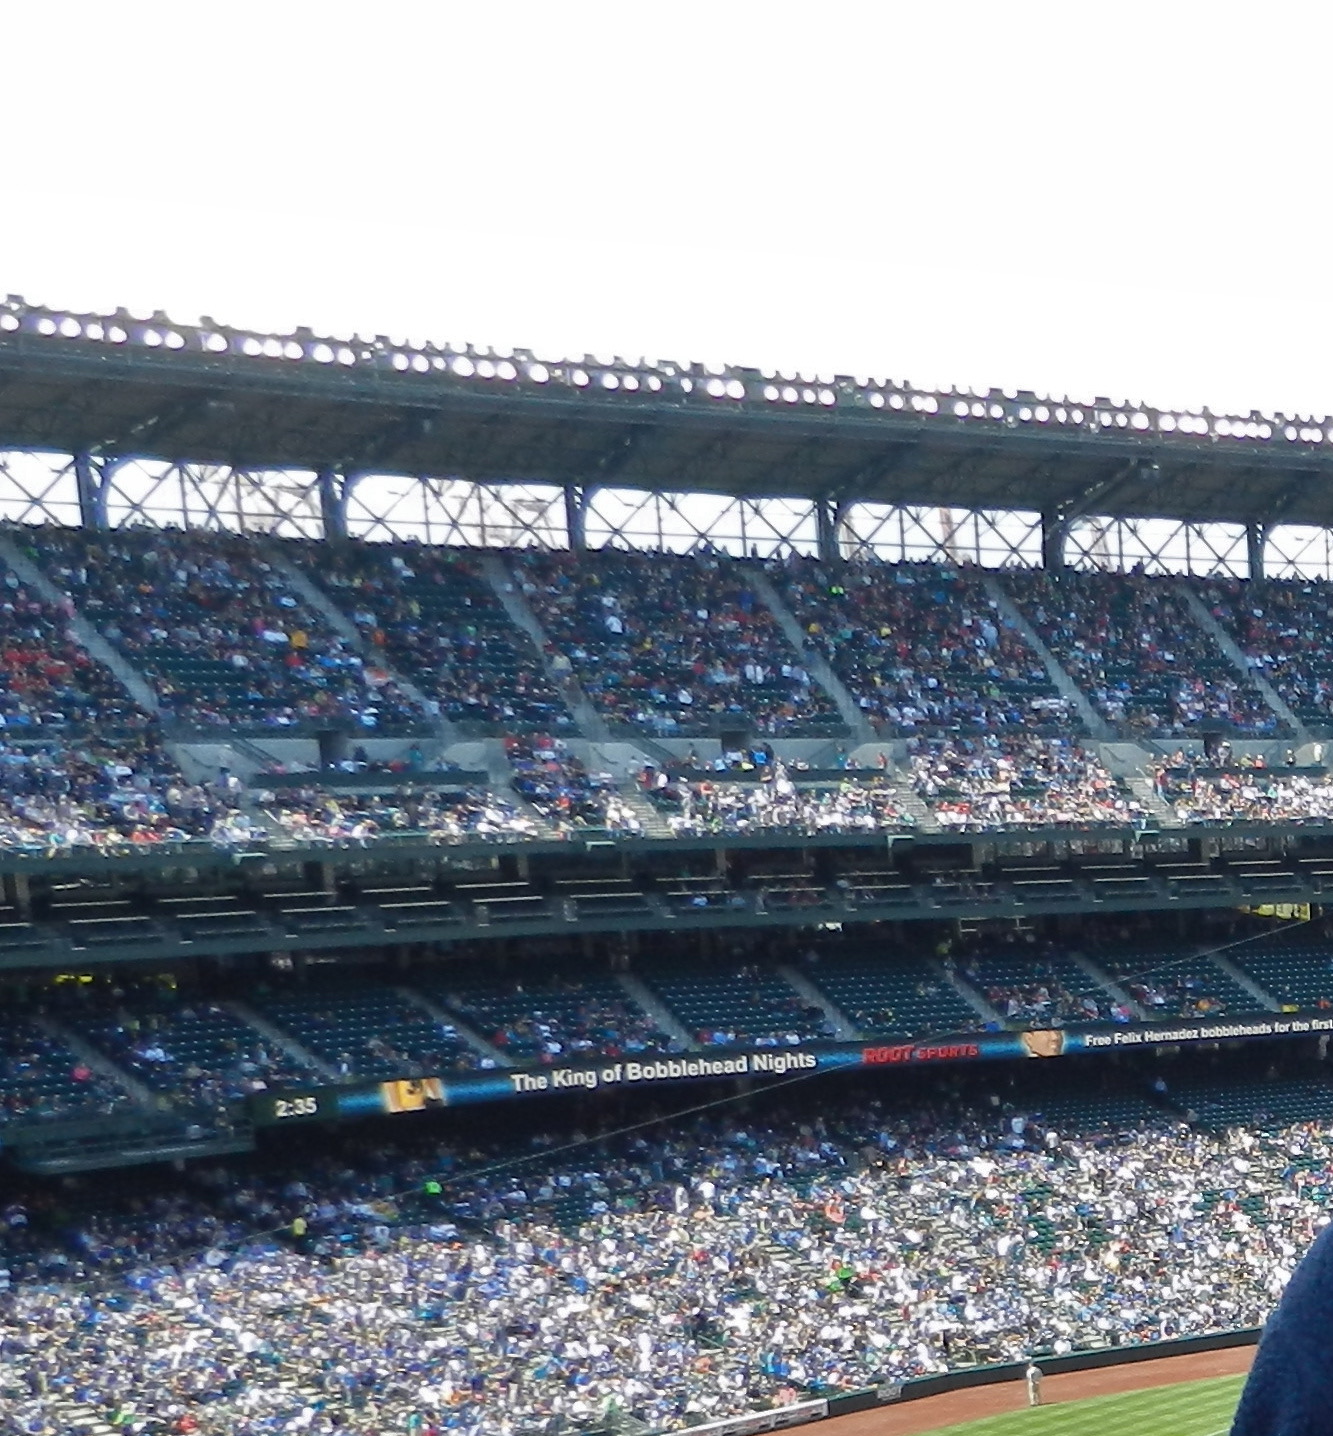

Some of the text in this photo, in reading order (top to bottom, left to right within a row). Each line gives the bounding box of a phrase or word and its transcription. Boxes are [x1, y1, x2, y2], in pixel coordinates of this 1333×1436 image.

[1085, 1034, 1111, 1047] Free
[1114, 1032, 1142, 1045] Felix
[1201, 1021, 1271, 1039] bobbleheads
[1274, 1021, 1290, 1033] for
[1293, 1019, 1309, 1032] the
[1312, 1018, 1333, 1031] first
[863, 1044, 978, 1064] ROOT SPORTS
[511, 1052, 817, 1093] The King of Bobblehead Nights
[275, 1096, 317, 1118] 2:35
